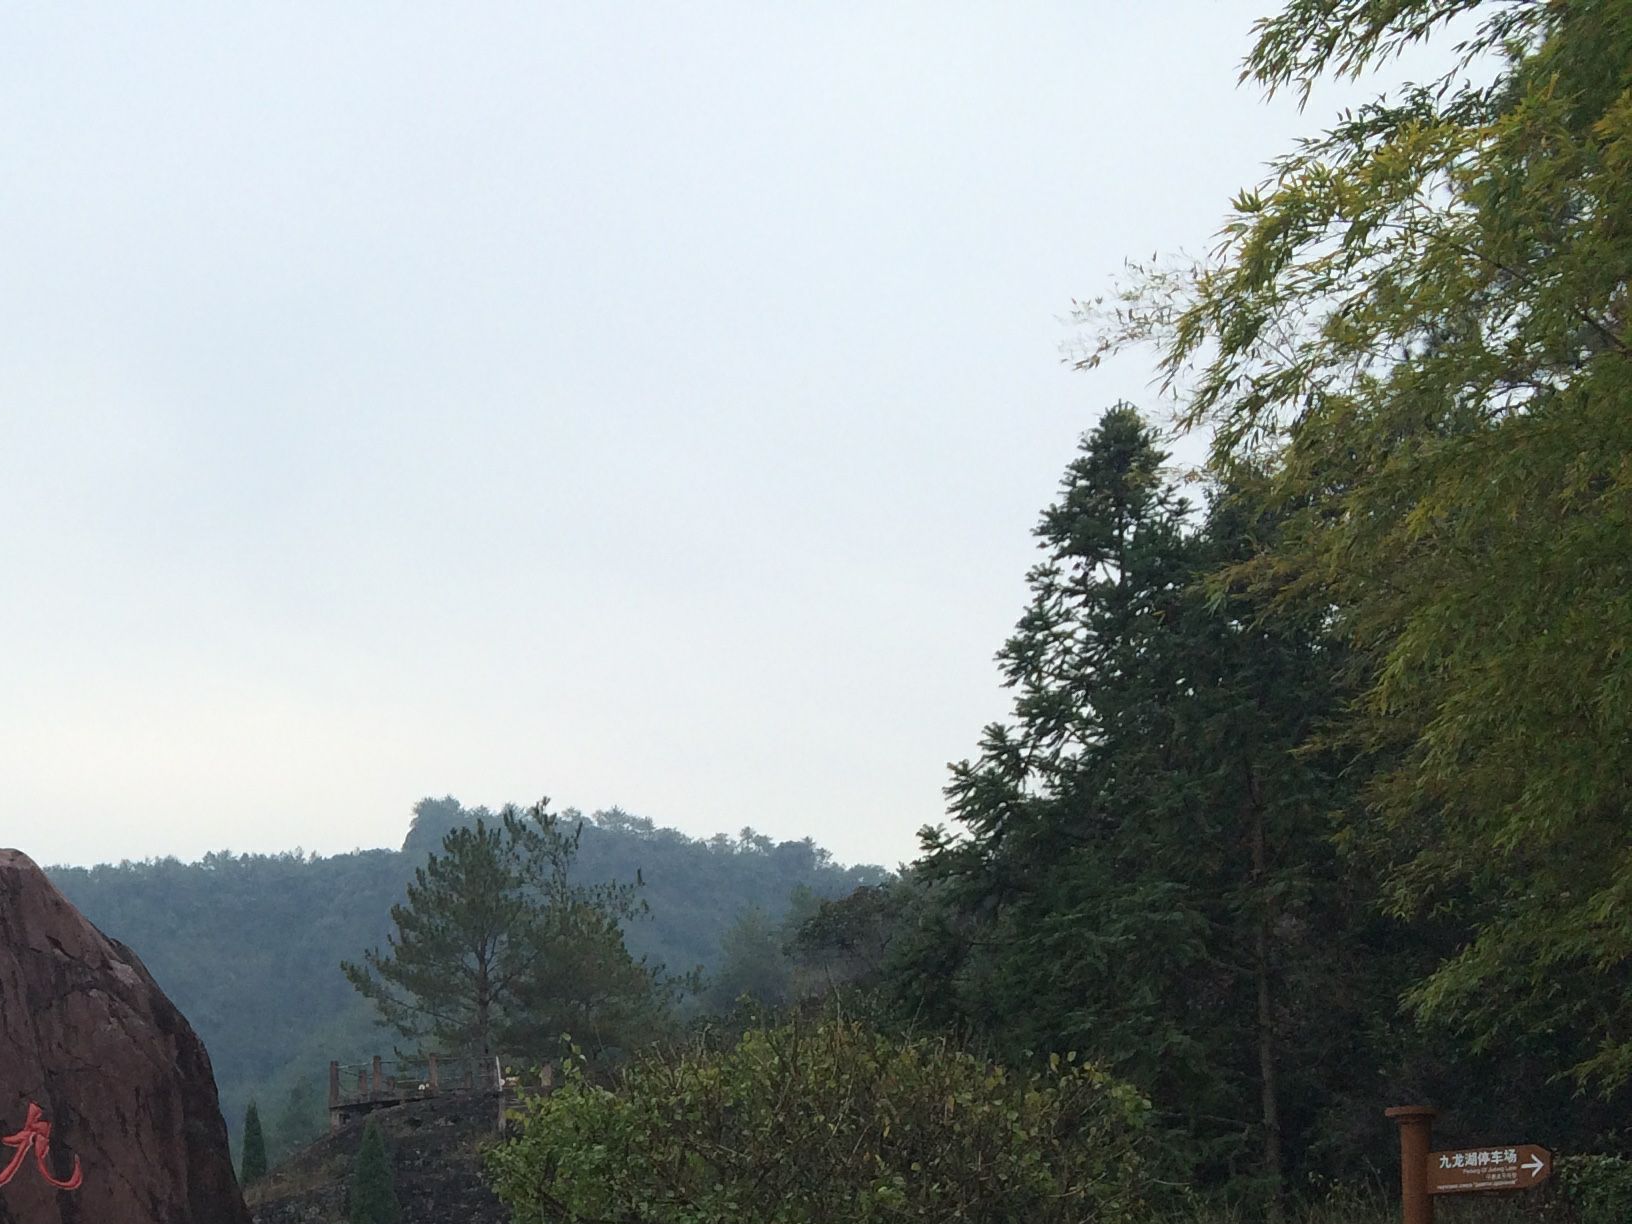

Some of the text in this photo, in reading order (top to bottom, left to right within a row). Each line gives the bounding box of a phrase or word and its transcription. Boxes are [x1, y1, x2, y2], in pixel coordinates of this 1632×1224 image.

[1439, 1149, 1518, 1169] 九龙湖停车场
